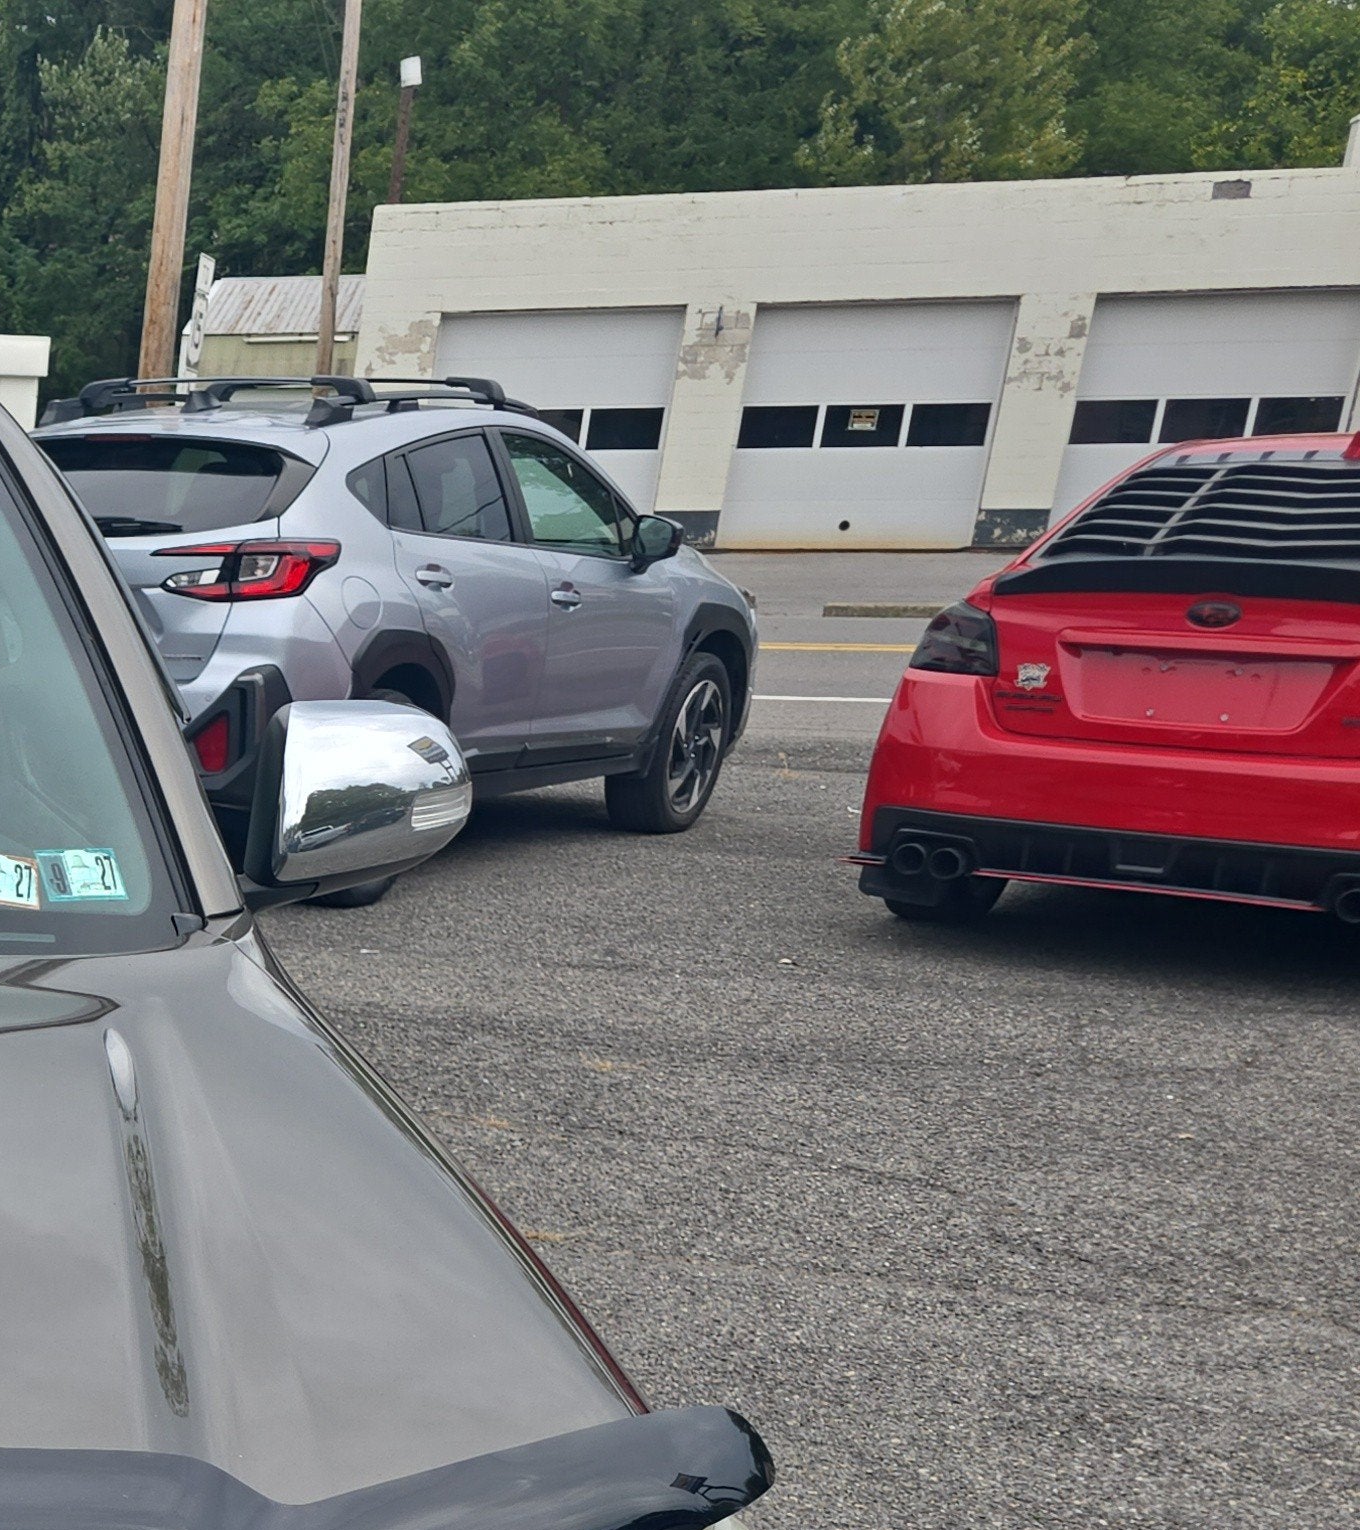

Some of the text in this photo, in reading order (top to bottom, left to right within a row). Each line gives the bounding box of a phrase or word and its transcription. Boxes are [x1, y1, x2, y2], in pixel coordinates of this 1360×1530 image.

[14, 864, 31, 901] 27
[51, 856, 117, 894] 9 27
